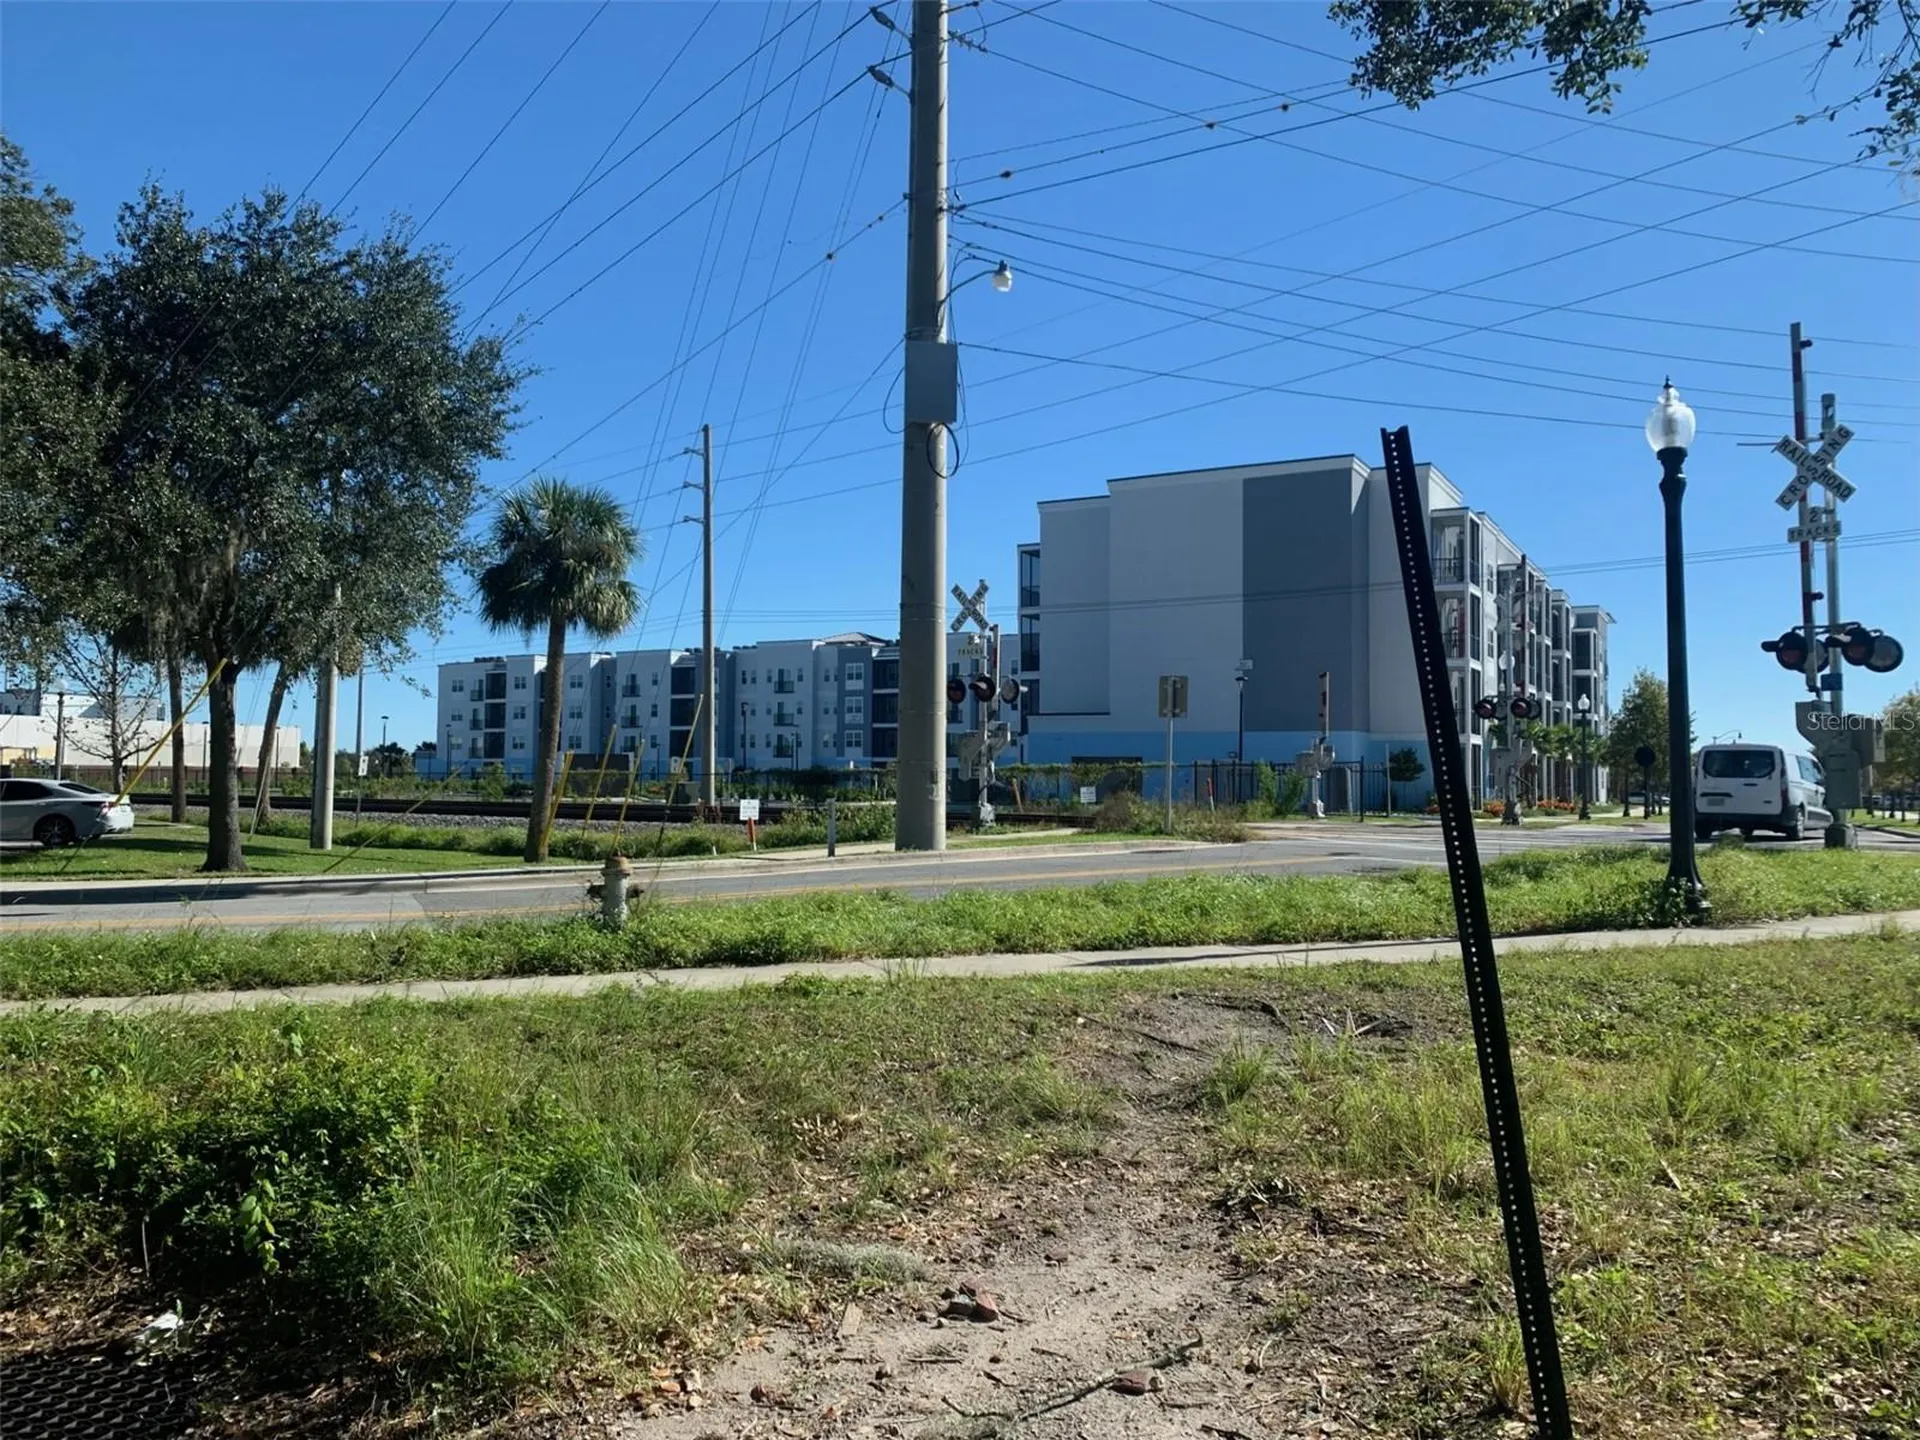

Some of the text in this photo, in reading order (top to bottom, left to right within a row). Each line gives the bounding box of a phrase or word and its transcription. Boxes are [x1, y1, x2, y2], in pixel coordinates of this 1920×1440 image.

[1780, 426, 1850, 507] CROSSING
[1809, 510, 1818, 523] 2
[1790, 523, 1841, 539] TRACKS
